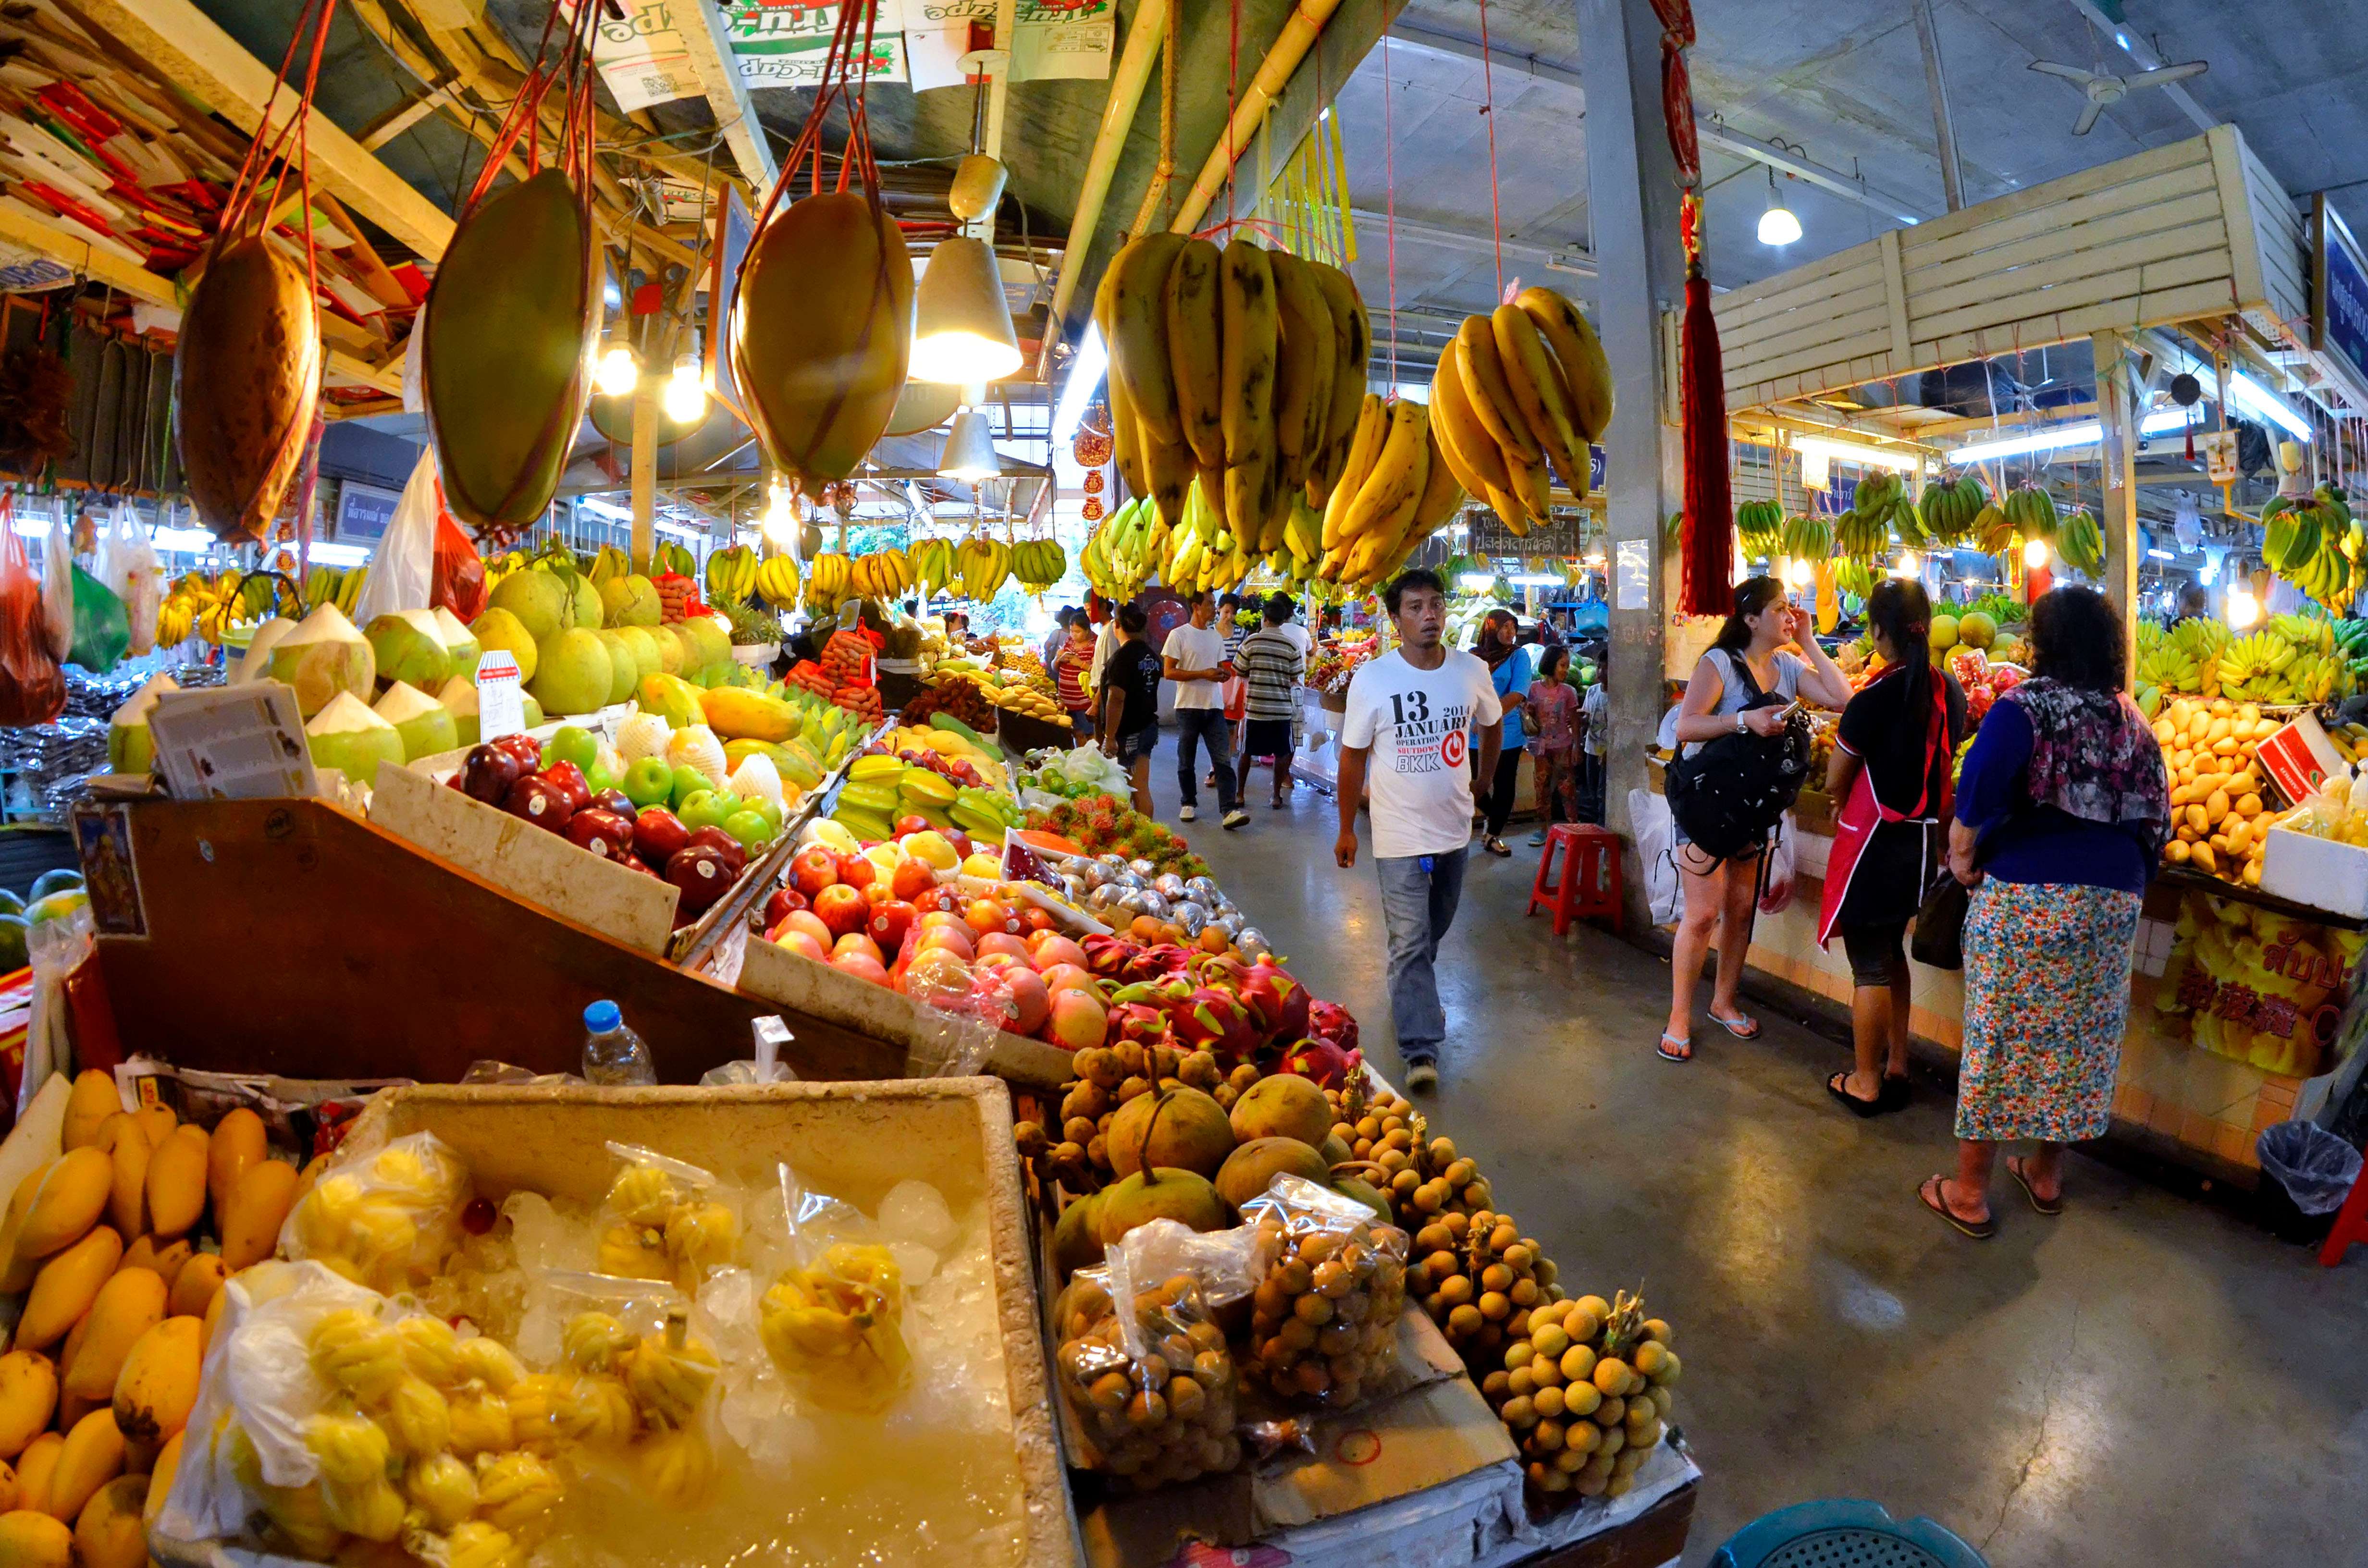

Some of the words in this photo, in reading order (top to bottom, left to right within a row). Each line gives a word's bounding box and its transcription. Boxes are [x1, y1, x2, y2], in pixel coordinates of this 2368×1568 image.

[924, 0, 1089, 24] Tru-ape
[739, 58, 876, 79] Tru-Cap
[1390, 690, 1430, 724] 13
[1443, 705, 1470, 717] 2014
[1395, 716, 1467, 738] JANUARY
[1396, 735, 1441, 747] OPERATION
[1397, 744, 1441, 754] SHUTDOWN
[1395, 752, 1441, 773] BKK
[2279, 766, 2302, 795] CARROT
